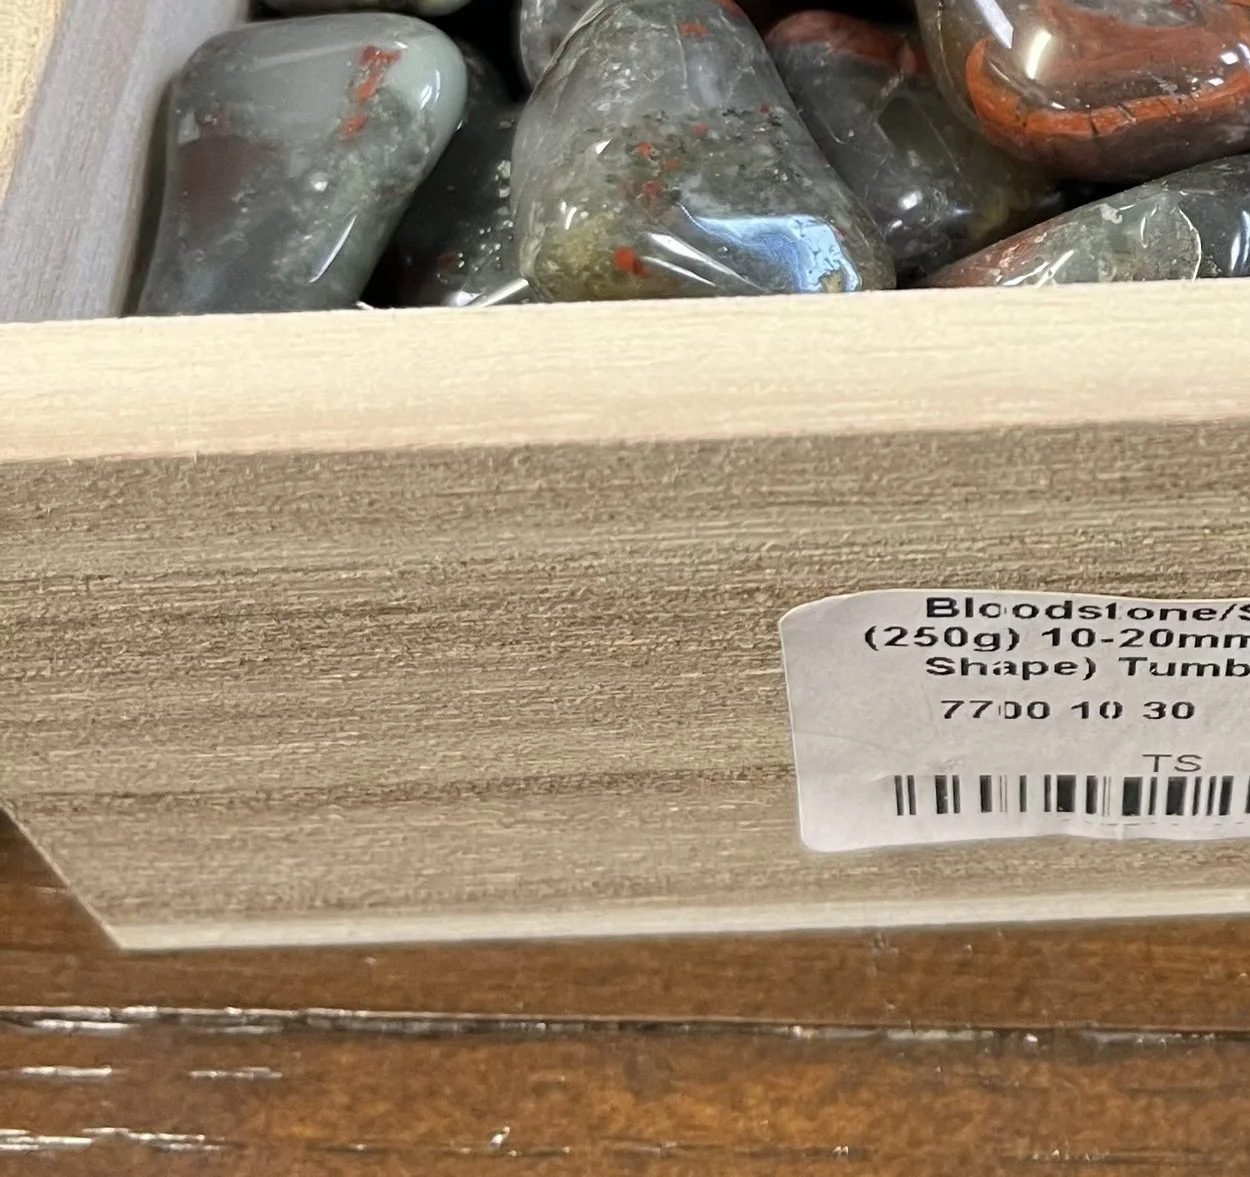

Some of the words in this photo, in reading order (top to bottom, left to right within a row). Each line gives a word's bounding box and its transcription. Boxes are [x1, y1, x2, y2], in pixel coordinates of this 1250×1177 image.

[865, 625, 1020, 651] (250g)
[925, 656, 1096, 681] Shape)
[940, 700, 1051, 720] 7700
[1070, 701, 1124, 720] 10
[1142, 701, 1196, 720] 30
[1142, 754, 1202, 773] TS
